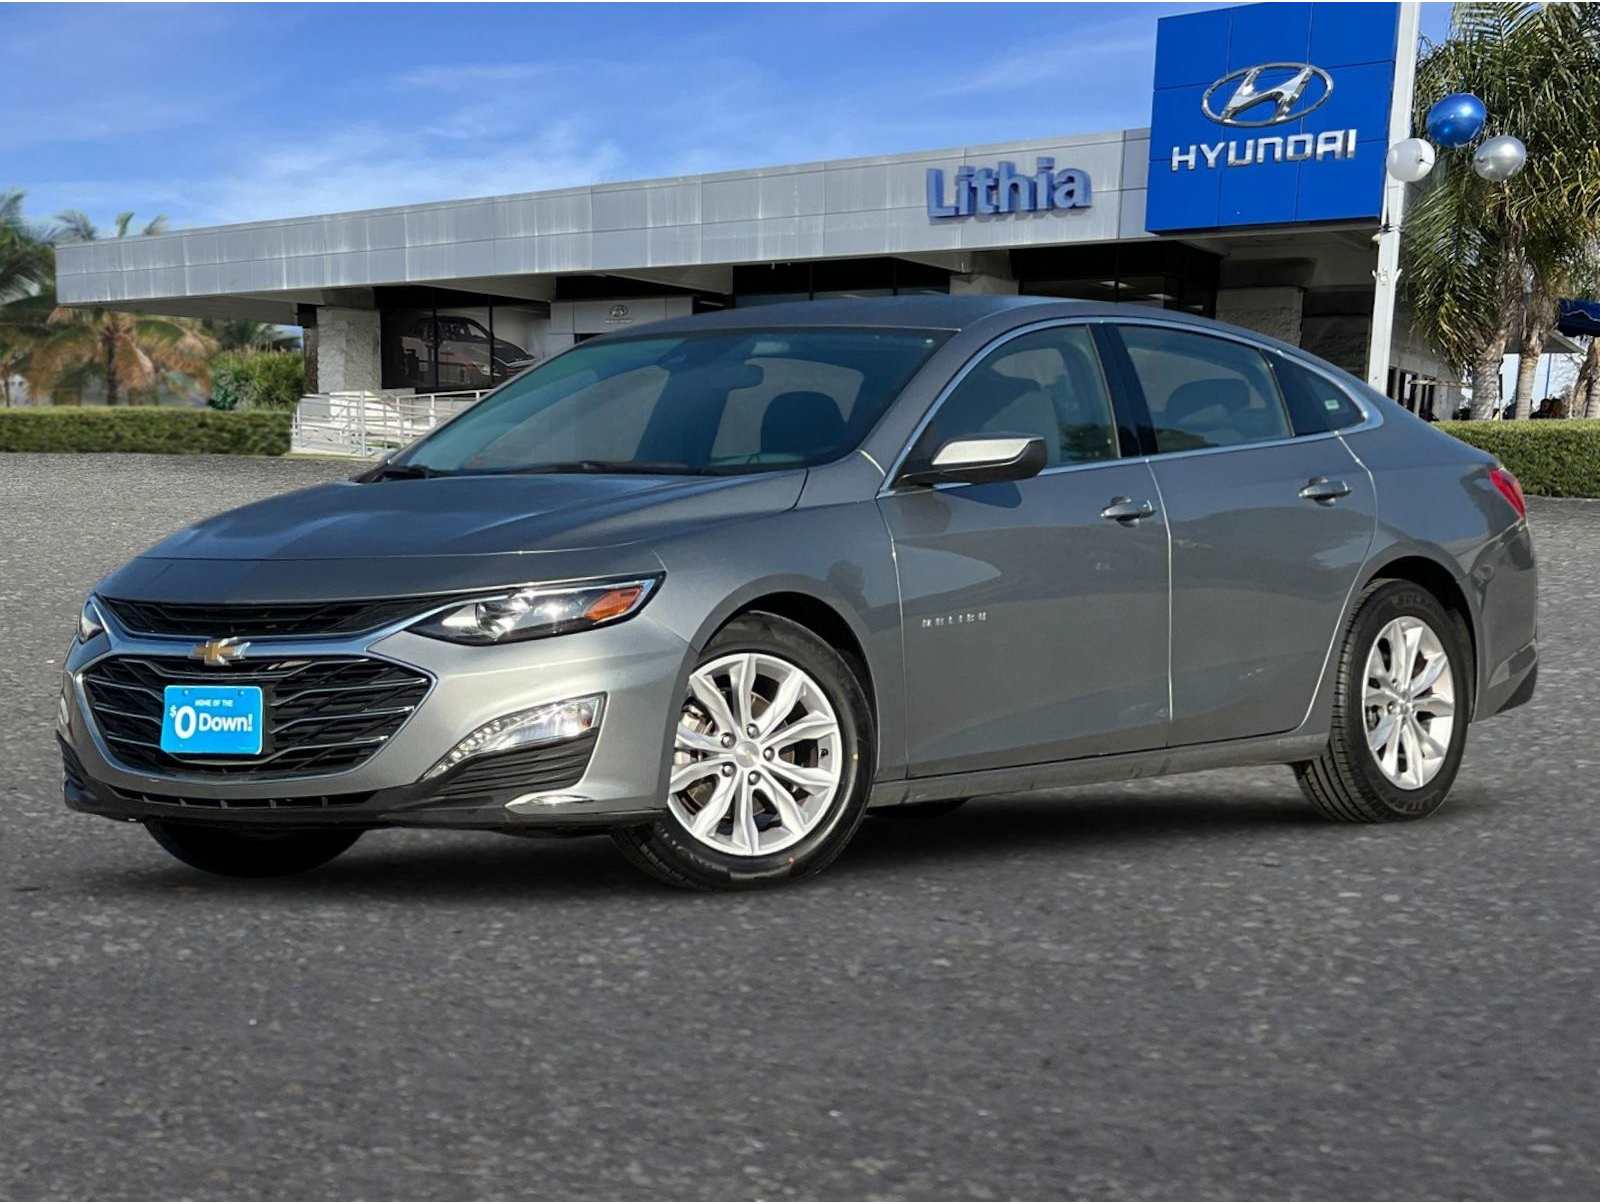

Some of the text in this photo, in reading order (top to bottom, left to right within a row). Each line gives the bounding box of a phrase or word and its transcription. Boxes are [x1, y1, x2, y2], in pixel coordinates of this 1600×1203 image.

[1171, 129, 1357, 172] HYUNDAI
[926, 156, 1092, 217] Lithia
[212, 699, 221, 707] OF
[222, 699, 234, 707] THE
[198, 712, 253, 732] Down!
